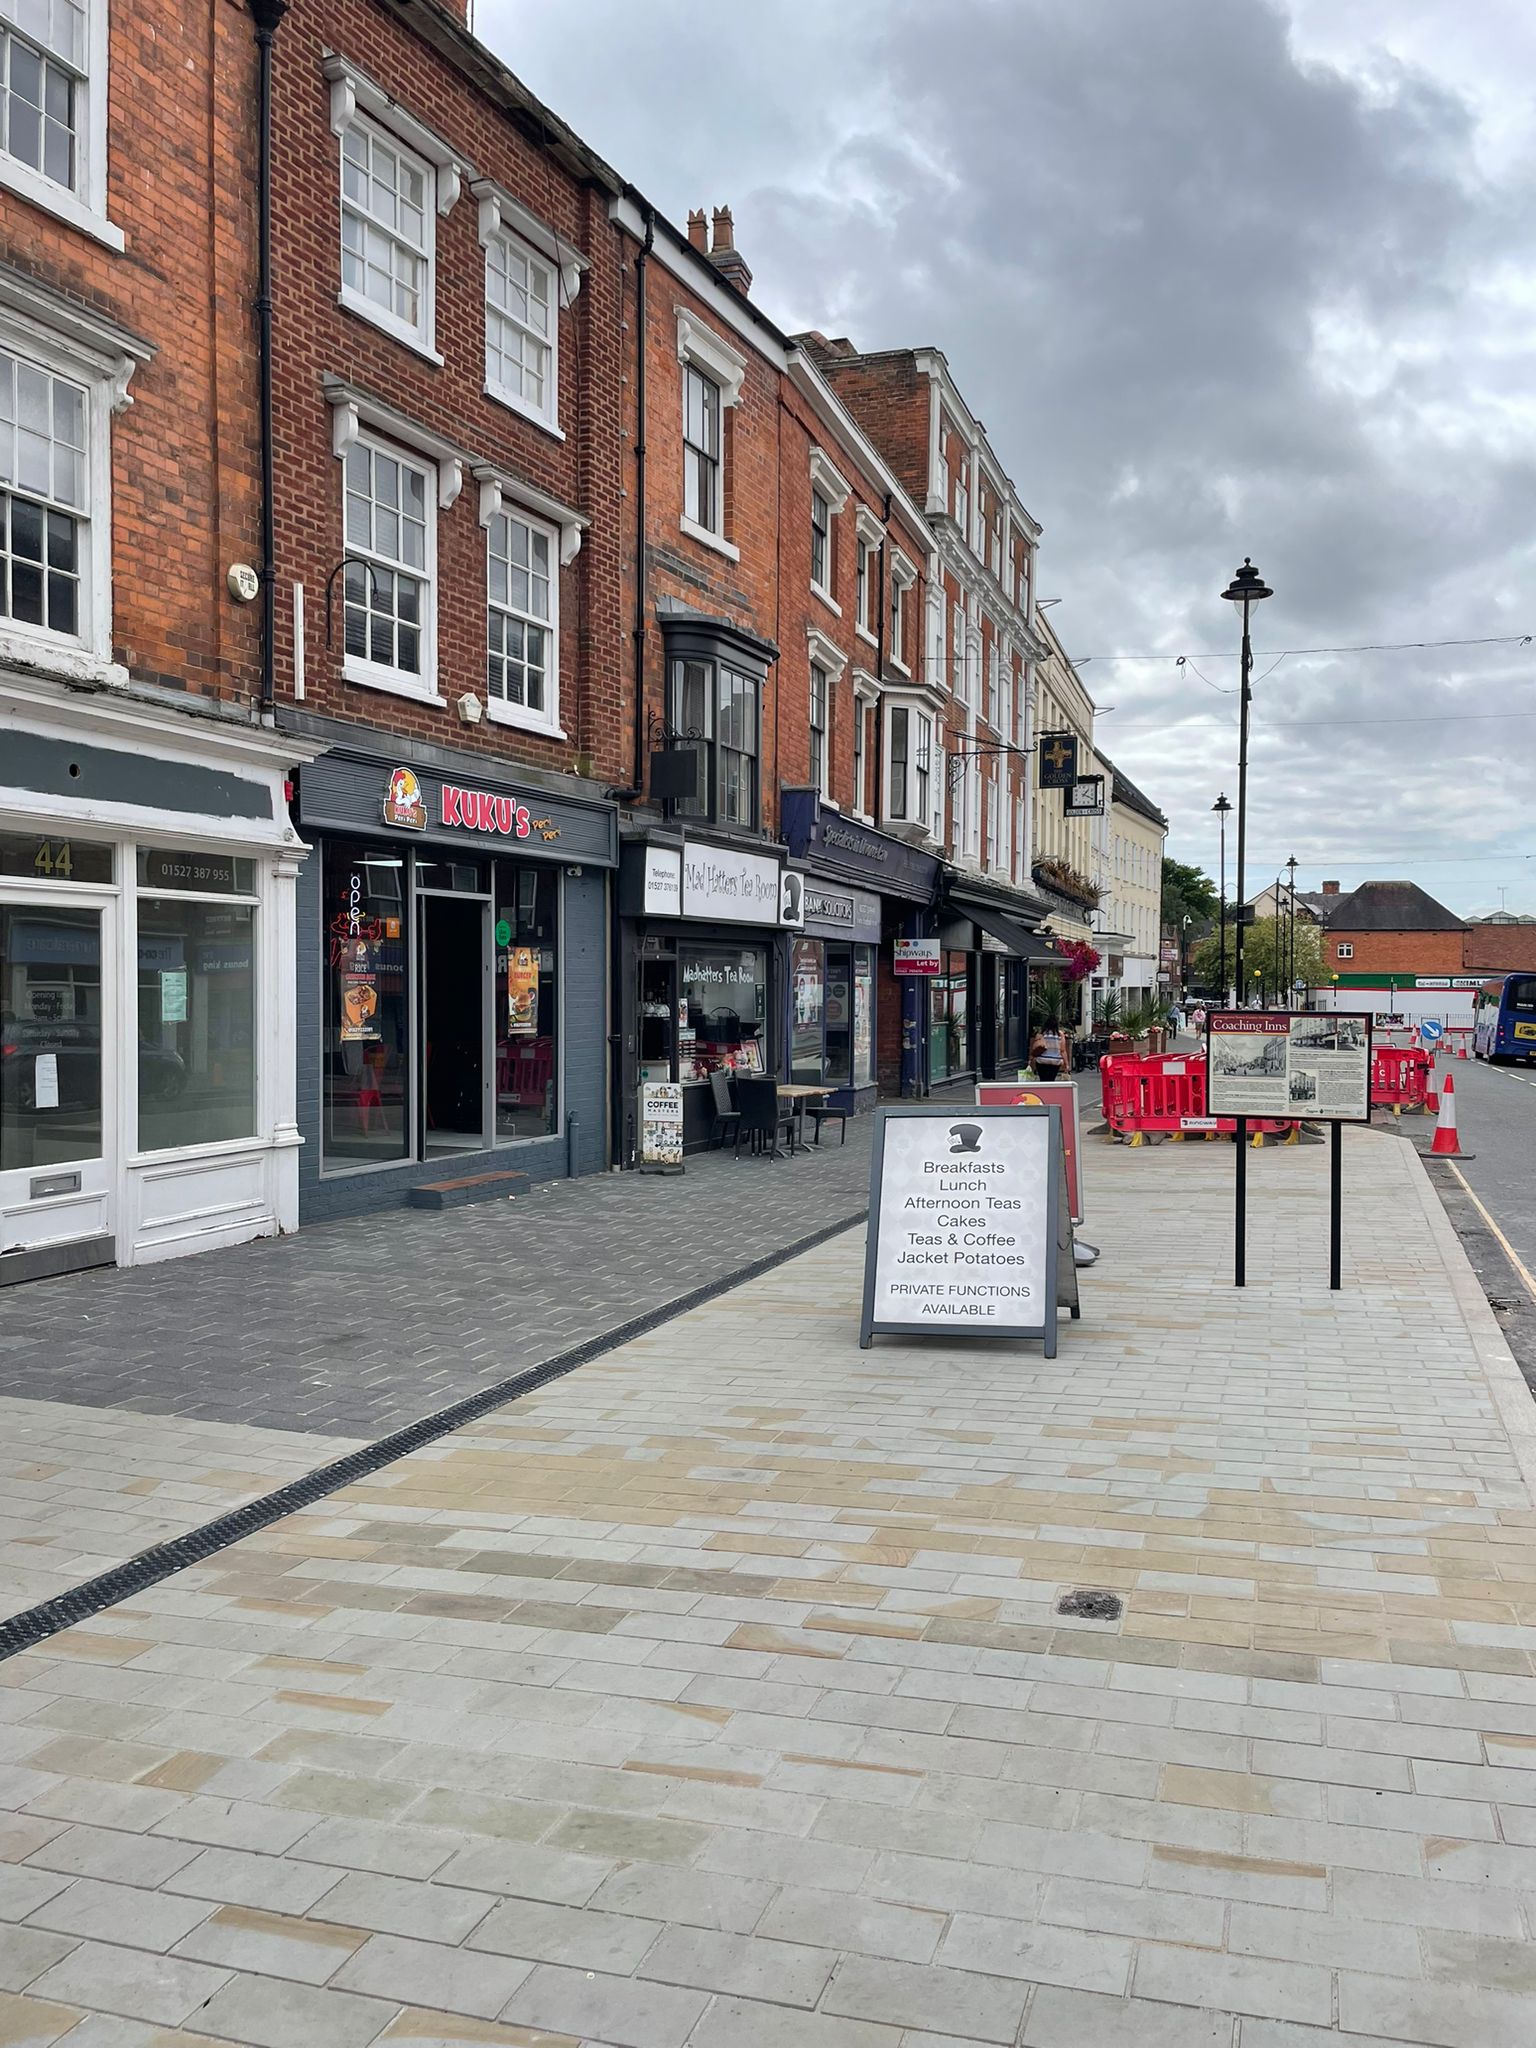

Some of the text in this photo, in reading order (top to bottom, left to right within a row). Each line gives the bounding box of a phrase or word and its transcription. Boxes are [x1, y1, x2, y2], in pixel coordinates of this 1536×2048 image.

[1043, 772, 1072, 780] GOLDEN
[34, 840, 73, 876] 44
[161, 863, 230, 881] 01527 387 955
[685, 862, 777, 902] Mad Hatters Tea Room
[823, 899, 852, 919] SOLICITORS
[895, 948, 933, 959] shipways
[929, 960, 940, 968] by
[683, 963, 754, 984] Madhatters Tea Room
[1213, 1019, 1287, 1034] Coaching Inns
[647, 1101, 679, 1109] COFFEE
[924, 1161, 1005, 1174] Breakfasts
[940, 1179, 987, 1191] Lunch
[904, 1197, 1021, 1209] Afternoon Teas
[937, 1215, 986, 1227] Cakes
[908, 1233, 1016, 1246] Teas & Coffee
[897, 1251, 1025, 1265] Jacket Potatoes
[890, 1284, 1030, 1297] PRIVATE FUNCTIONS
[922, 1304, 996, 1316] AVAILABLE
